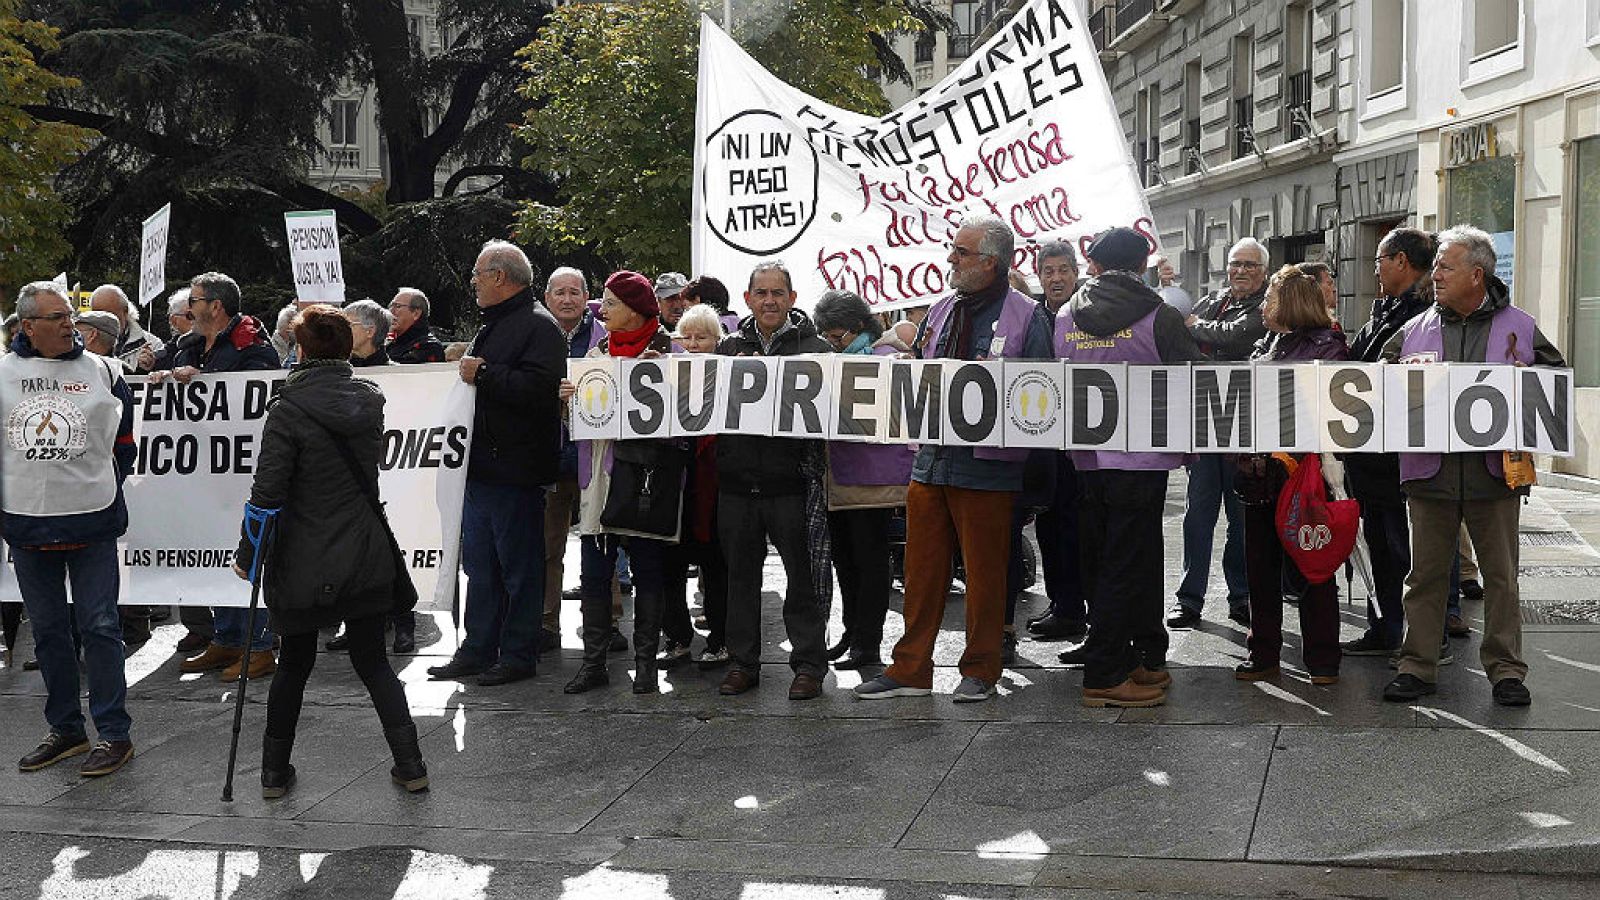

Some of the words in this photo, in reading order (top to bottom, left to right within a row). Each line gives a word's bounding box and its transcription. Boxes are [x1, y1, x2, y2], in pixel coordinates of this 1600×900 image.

[760, 132, 791, 158] UN
[729, 166, 788, 196] PASO
[724, 197, 804, 233] ATRÁS!
[22, 378, 60, 393] PARLA
[132, 380, 230, 422] FENSA
[628, 361, 998, 442] SUPREMO
[1072, 368, 1569, 454] DIMISIÓN
[26, 448, 69, 461] 0,25%
[135, 434, 199, 475] ICO
[211, 436, 253, 474] DE
[380, 425, 467, 470] ONES
[125, 550, 151, 566] LAS
